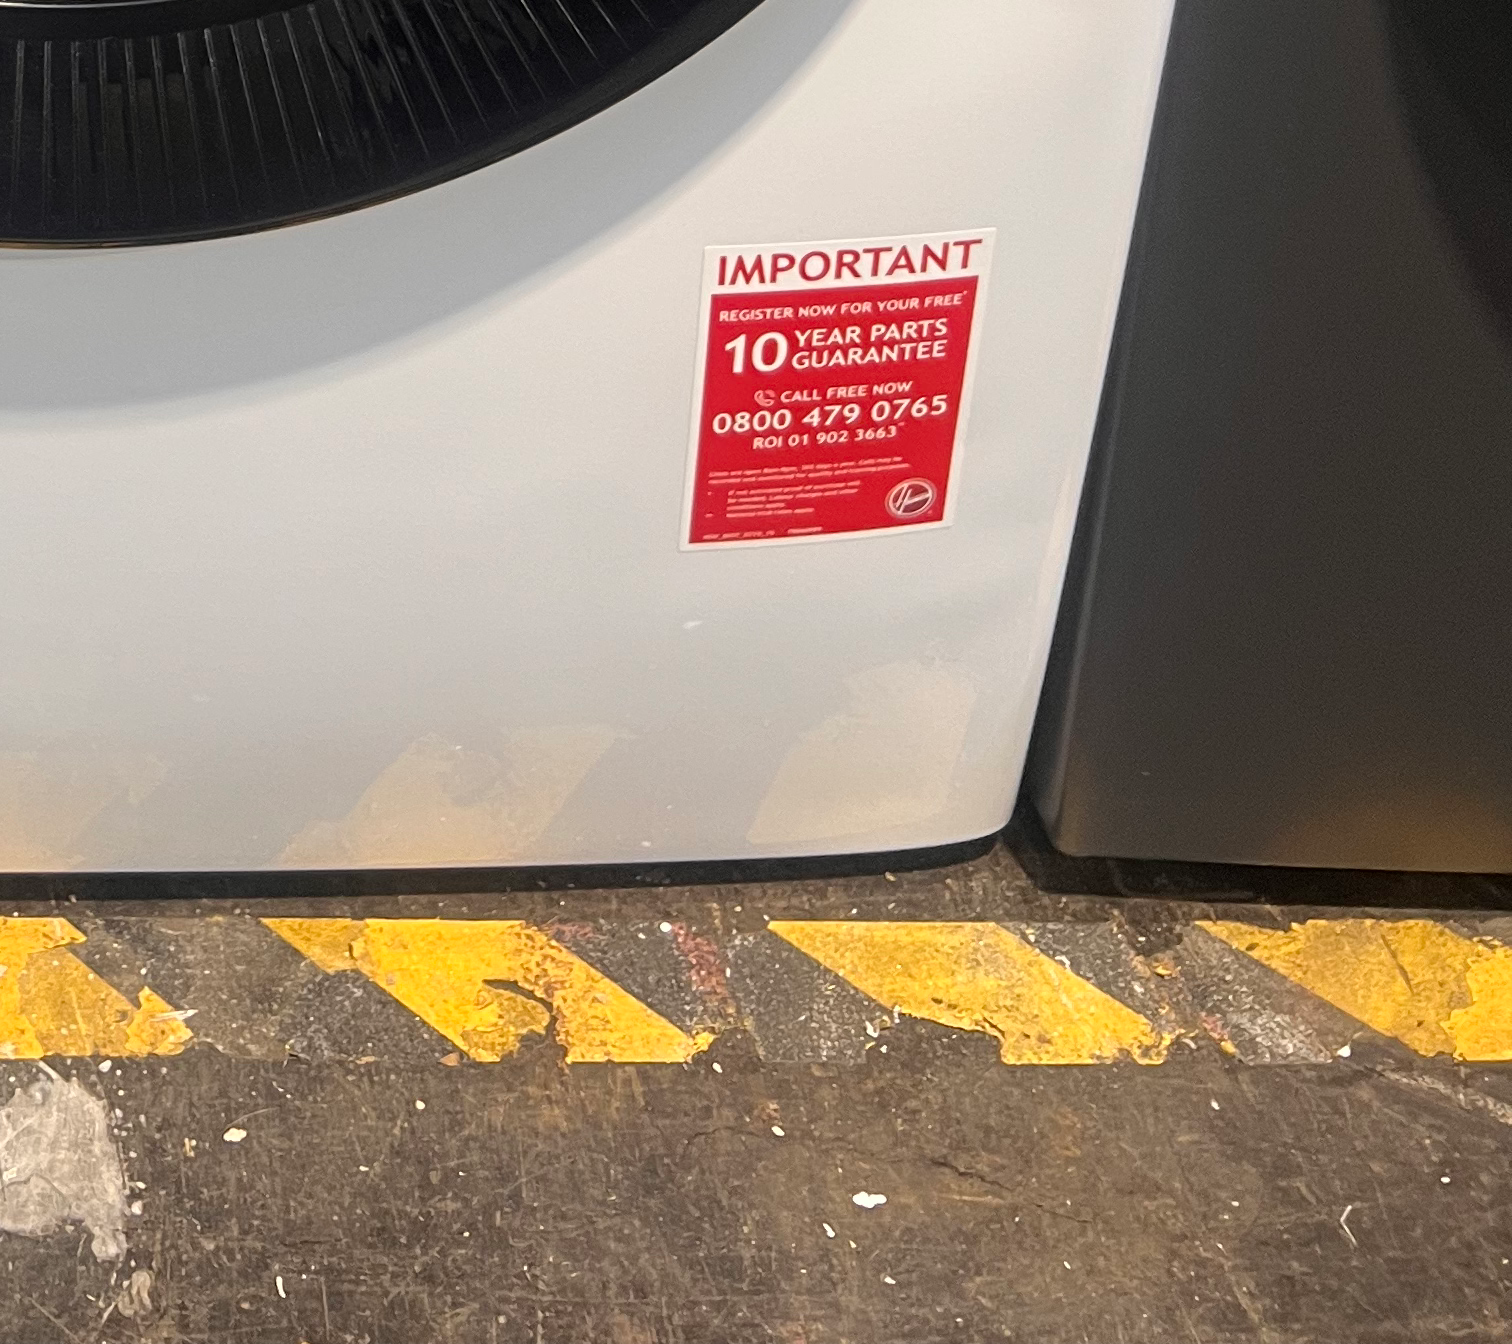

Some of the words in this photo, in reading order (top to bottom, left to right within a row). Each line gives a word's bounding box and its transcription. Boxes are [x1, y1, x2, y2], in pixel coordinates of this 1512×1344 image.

[718, 239, 983, 286] IMPORTANT
[719, 306, 794, 322] REGISTER
[798, 304, 836, 318] NOW
[840, 302, 871, 314] FOR
[877, 298, 919, 312] YOUR
[725, 331, 788, 374] 10
[795, 326, 861, 348] YEAR
[870, 318, 948, 342] PARTS
[792, 340, 947, 370] GUARANTEE
[781, 390, 821, 403] CALL
[827, 385, 868, 400] FREE
[873, 381, 912, 395] NOW
[712, 409, 792, 434] 0800
[802, 403, 859, 427] 479
[871, 395, 948, 421] 0765
[753, 434, 782, 449] ROI
[788, 434, 809, 447] 01
[816, 431, 848, 444] 902
